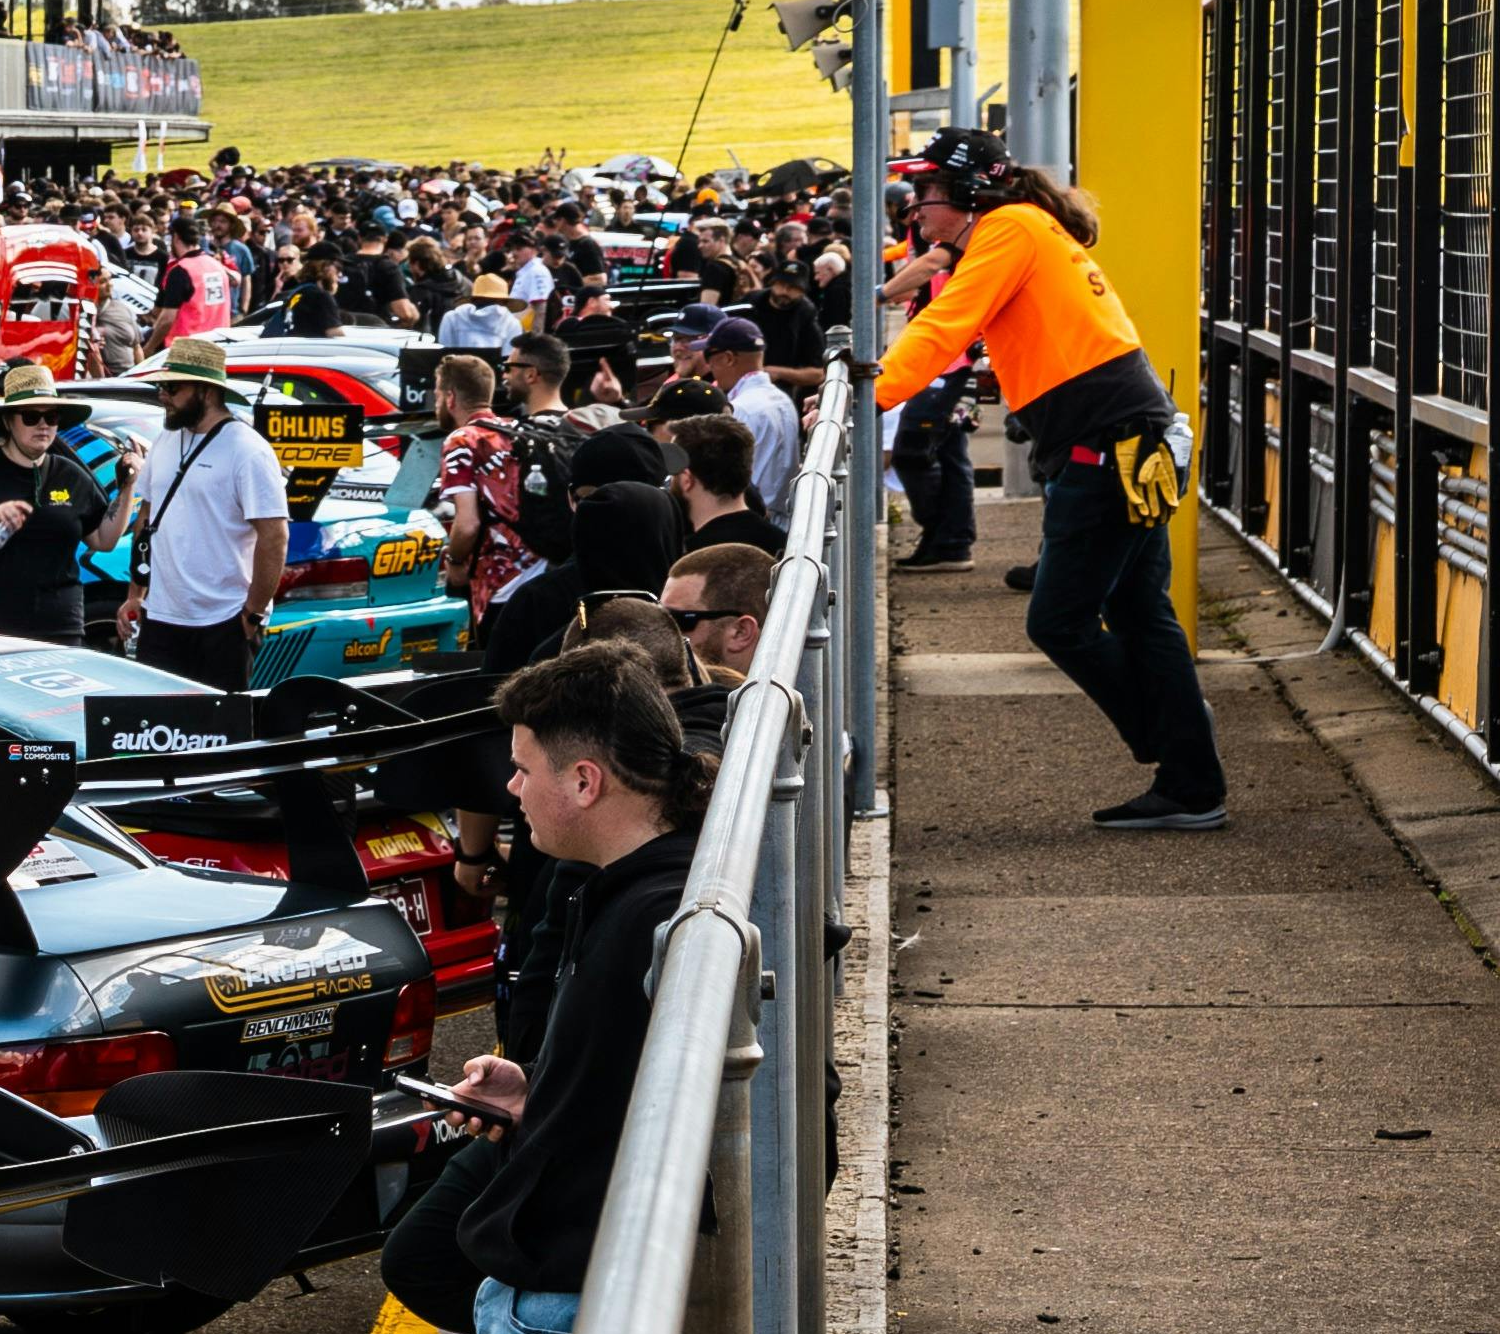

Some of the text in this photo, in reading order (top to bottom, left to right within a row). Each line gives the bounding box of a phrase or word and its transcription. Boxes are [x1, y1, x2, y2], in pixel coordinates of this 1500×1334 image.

[267, 410, 347, 439] ÖHLINS
[344, 636, 380, 658] alcon
[23, 745, 53, 753] SYDNEY
[23, 752, 70, 762] COMPOSITES
[315, 975, 372, 997] RACING
[244, 1007, 332, 1040] BENCHMARK
